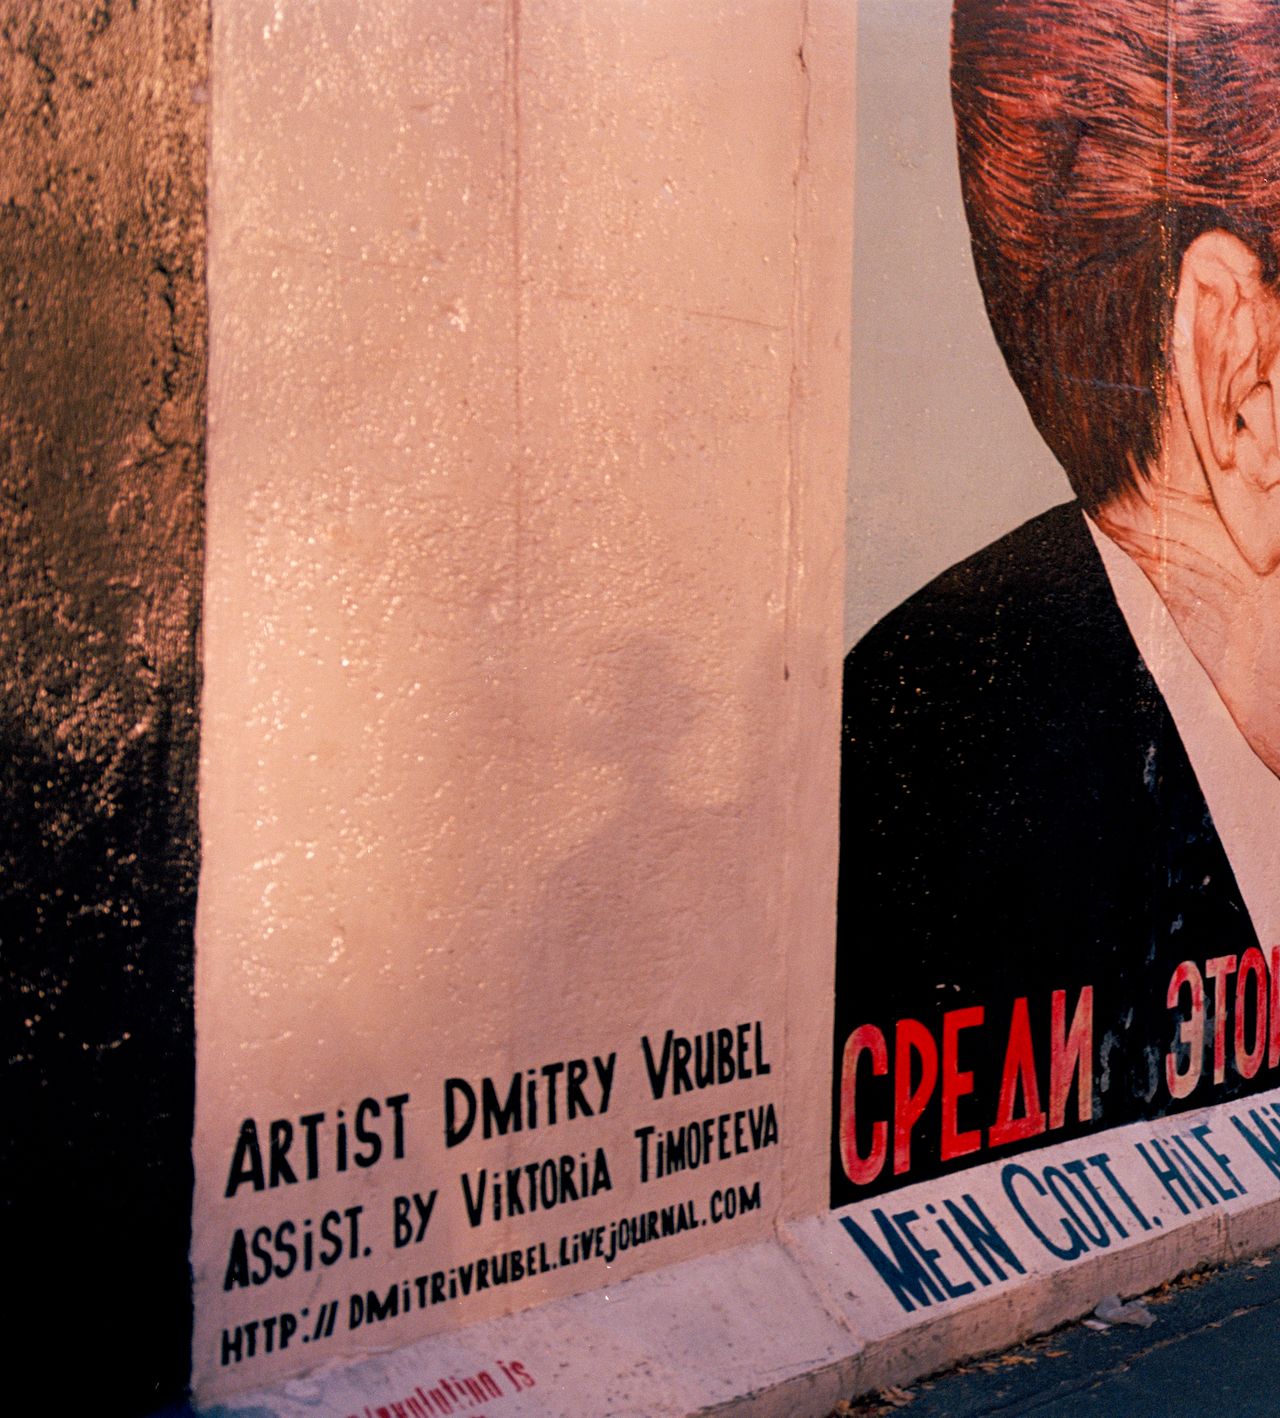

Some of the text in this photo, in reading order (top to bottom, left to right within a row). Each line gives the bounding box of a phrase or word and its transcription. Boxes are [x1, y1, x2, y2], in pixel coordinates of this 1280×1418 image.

[641, 1021, 771, 1100] VRUBEL
[839, 985, 1094, 1186] СРЕДИ
[496, 1360, 536, 1392] is
